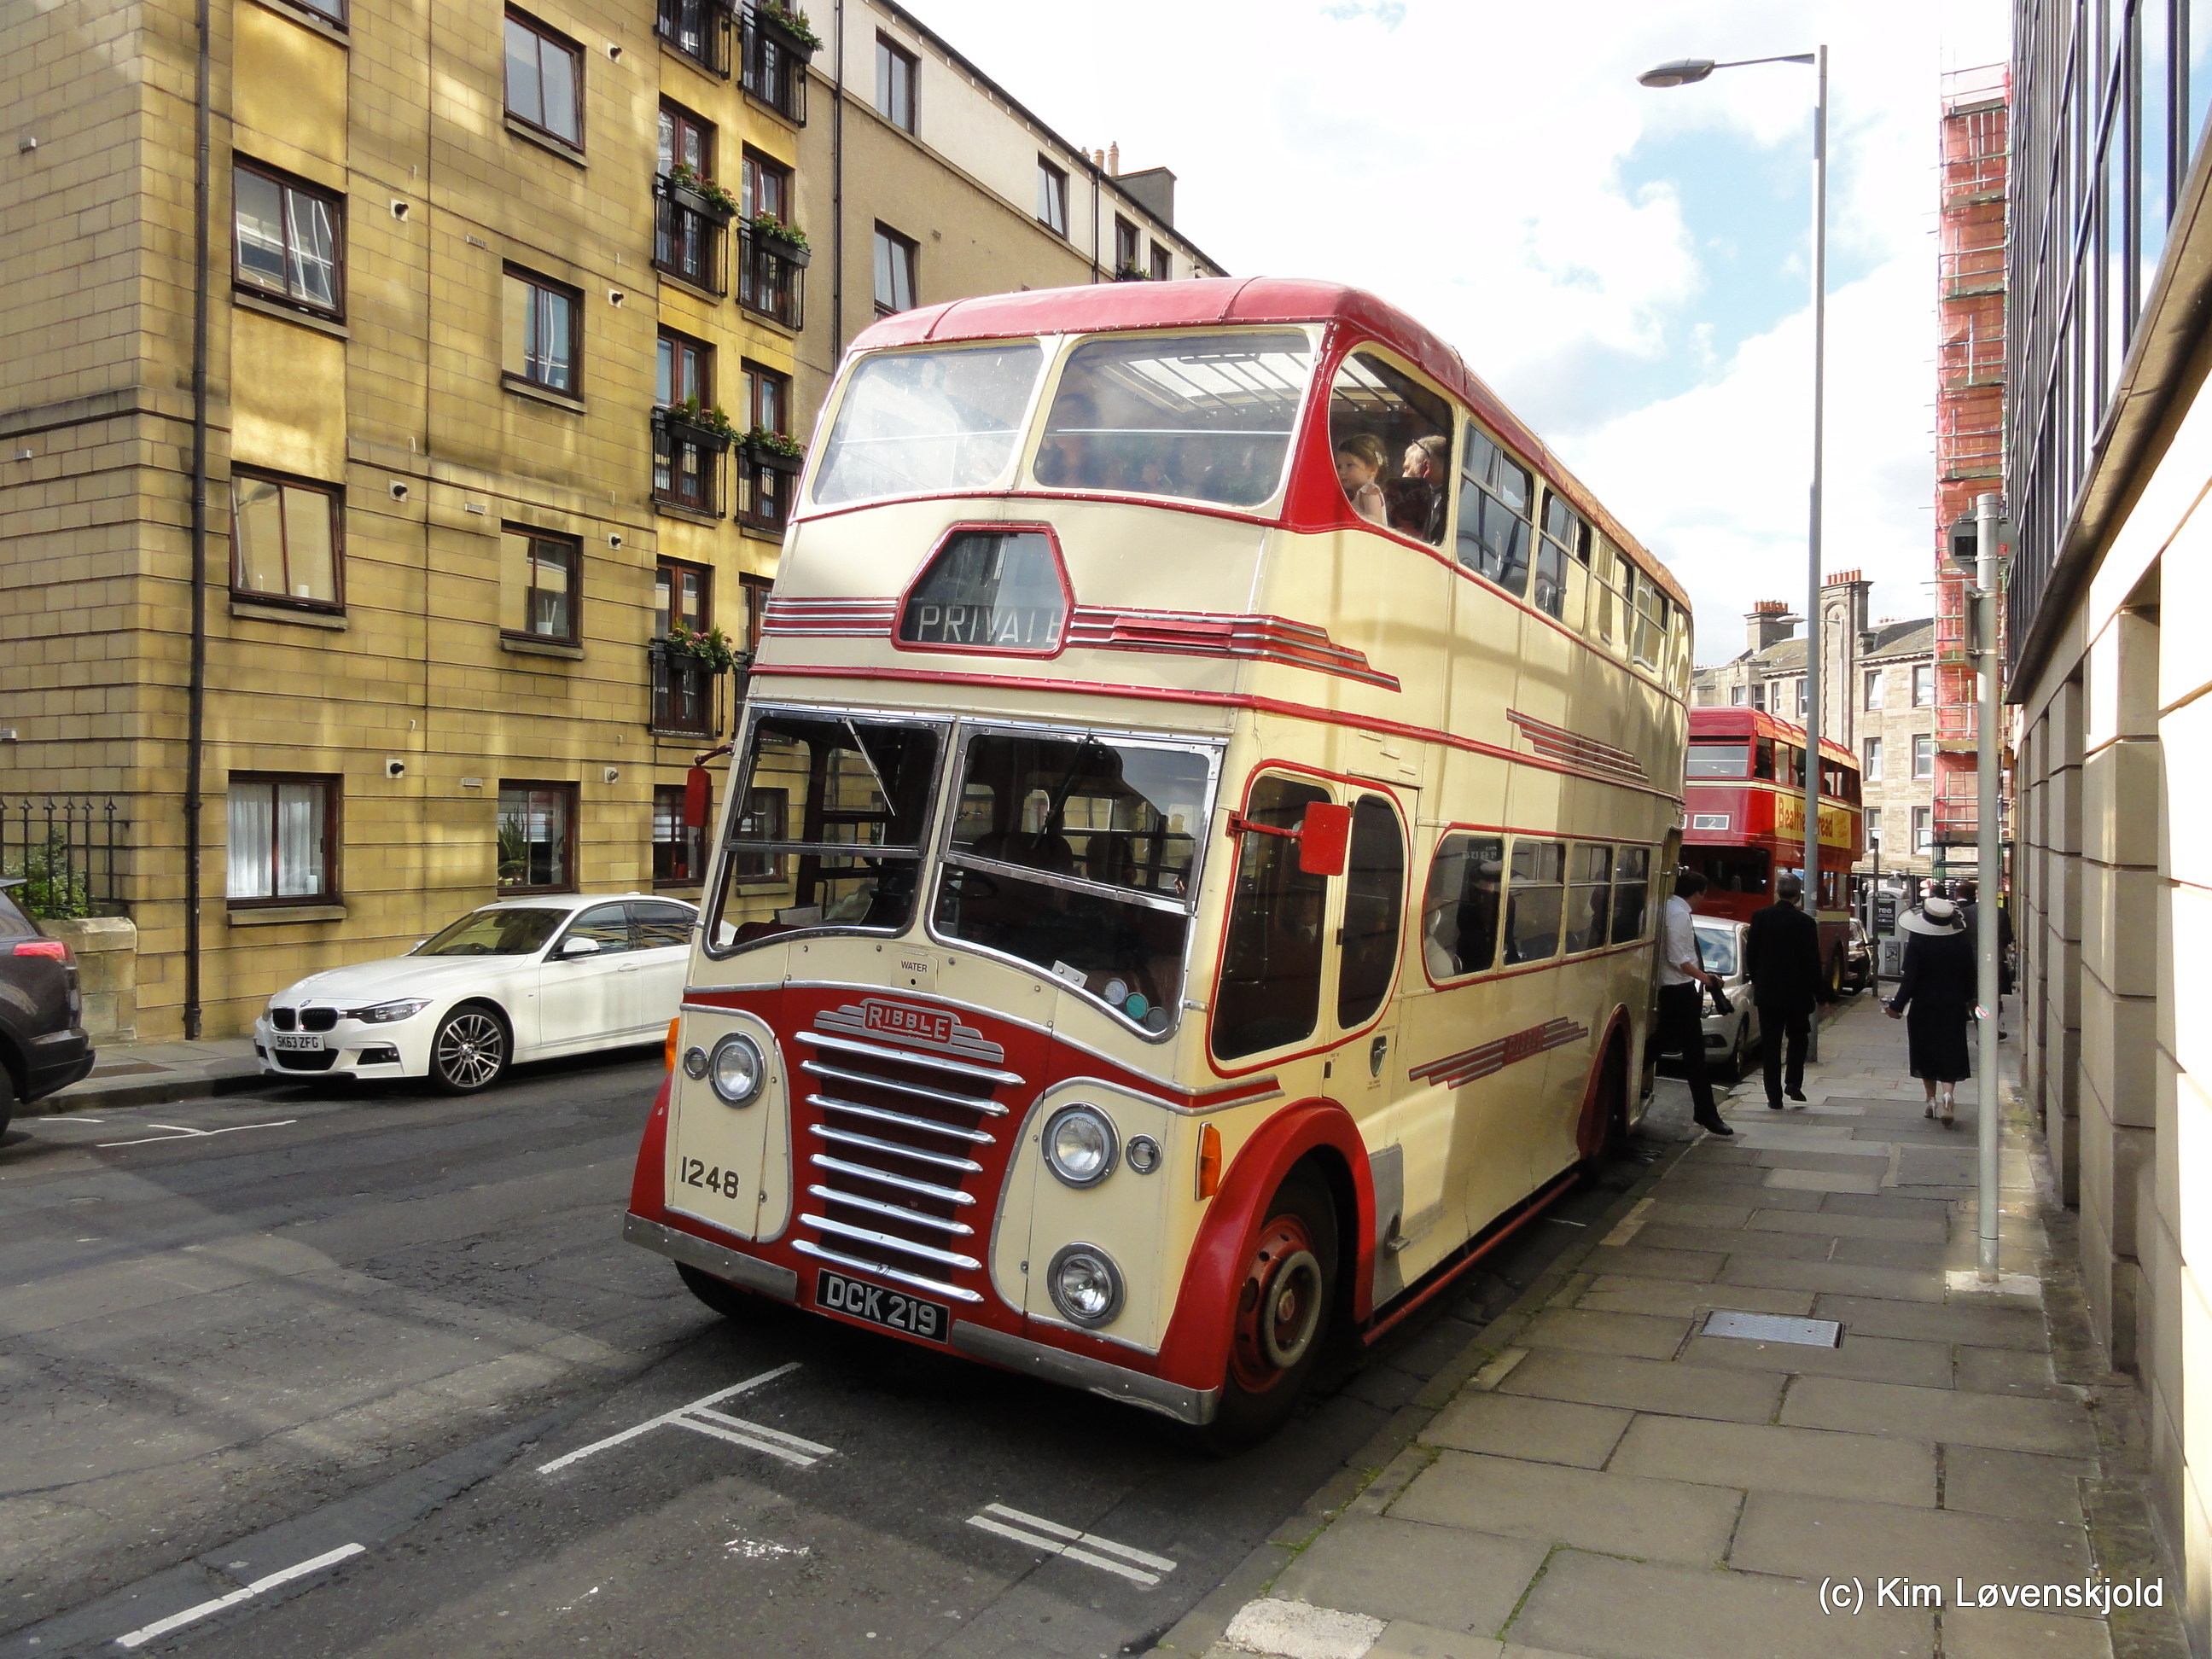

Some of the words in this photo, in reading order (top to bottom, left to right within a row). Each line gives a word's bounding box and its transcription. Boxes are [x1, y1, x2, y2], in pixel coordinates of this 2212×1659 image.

[1708, 818, 1716, 828] 2
[1818, 813, 1833, 837] read
[901, 960, 928, 973] WATER
[869, 1006, 949, 1040] RIBBLE
[276, 1035, 298, 1048] SK63
[299, 1036, 318, 1048] ZFG
[681, 1155, 739, 1200] 1248
[826, 1276, 883, 1322] DCK
[887, 1295, 937, 1336] 219
